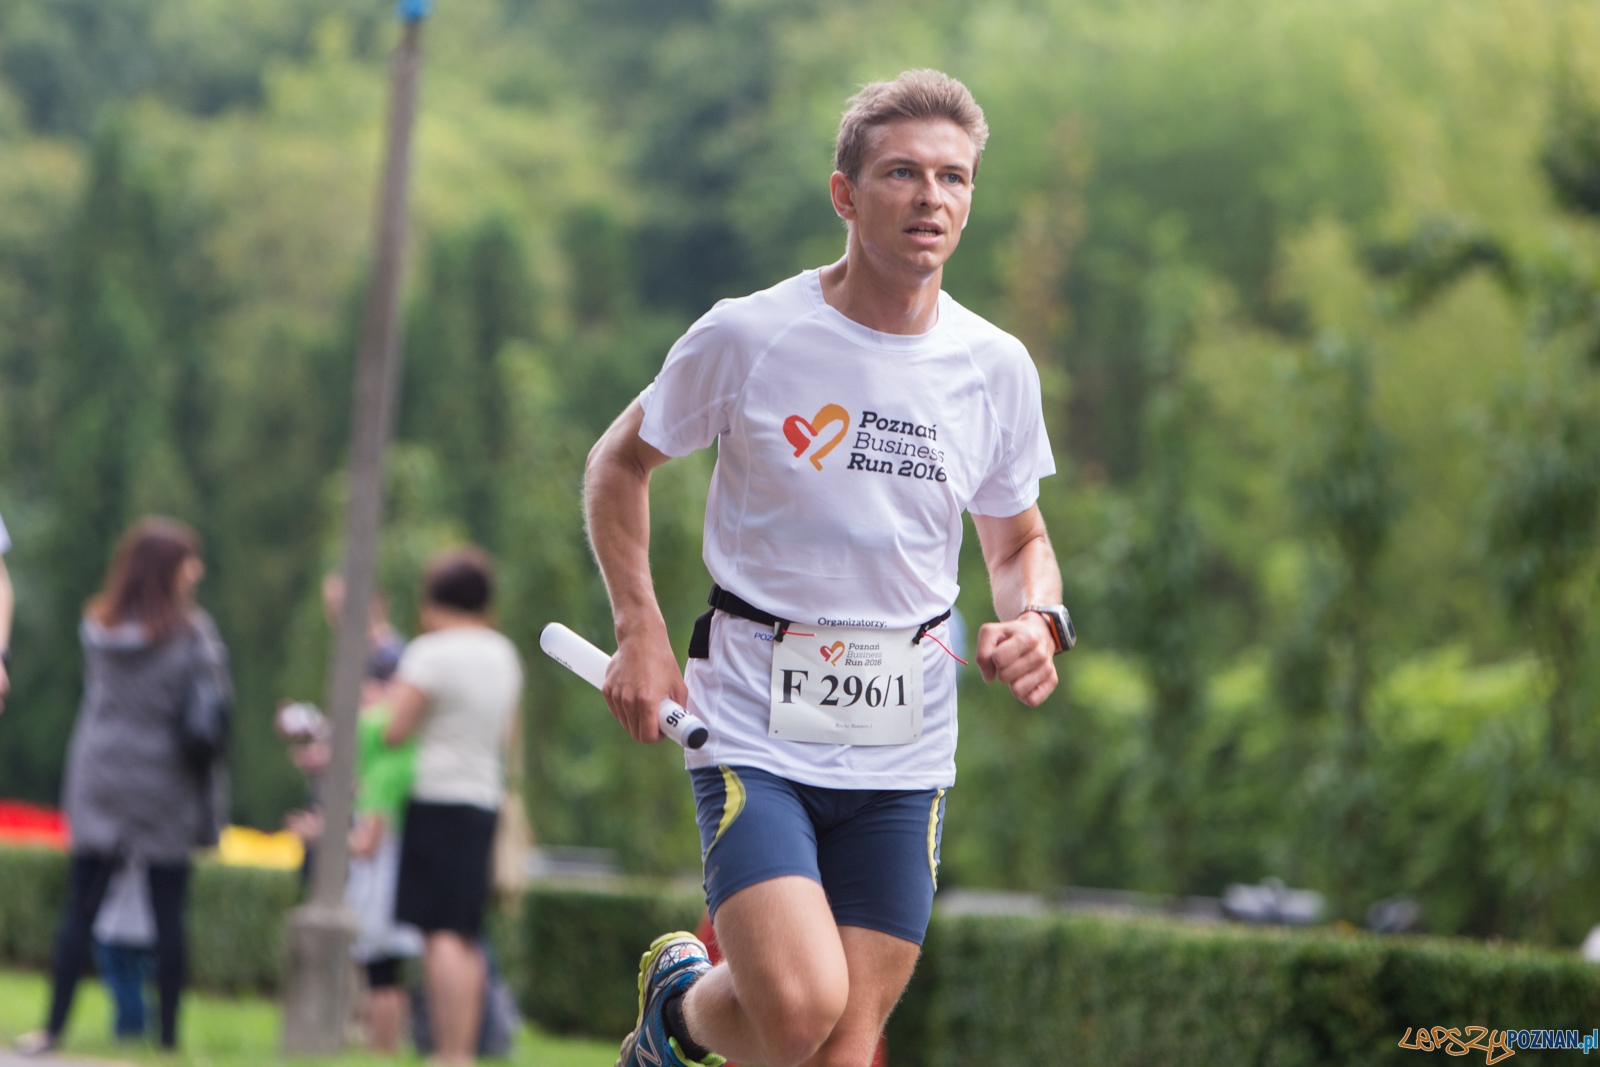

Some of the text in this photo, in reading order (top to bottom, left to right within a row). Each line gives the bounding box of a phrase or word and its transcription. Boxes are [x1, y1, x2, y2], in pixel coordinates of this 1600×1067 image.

[858, 410, 938, 441] Poznań
[852, 431, 945, 463] Business
[847, 452, 948, 483] Run 2016
[817, 616, 888, 629] Organizatorzy:
[754, 631, 774, 643] POZ
[848, 642, 880, 651] Poznań
[846, 650, 883, 659] Business
[844, 658, 883, 667] Run 2016
[778, 668, 809, 704] F
[819, 674, 908, 708] 296/1
